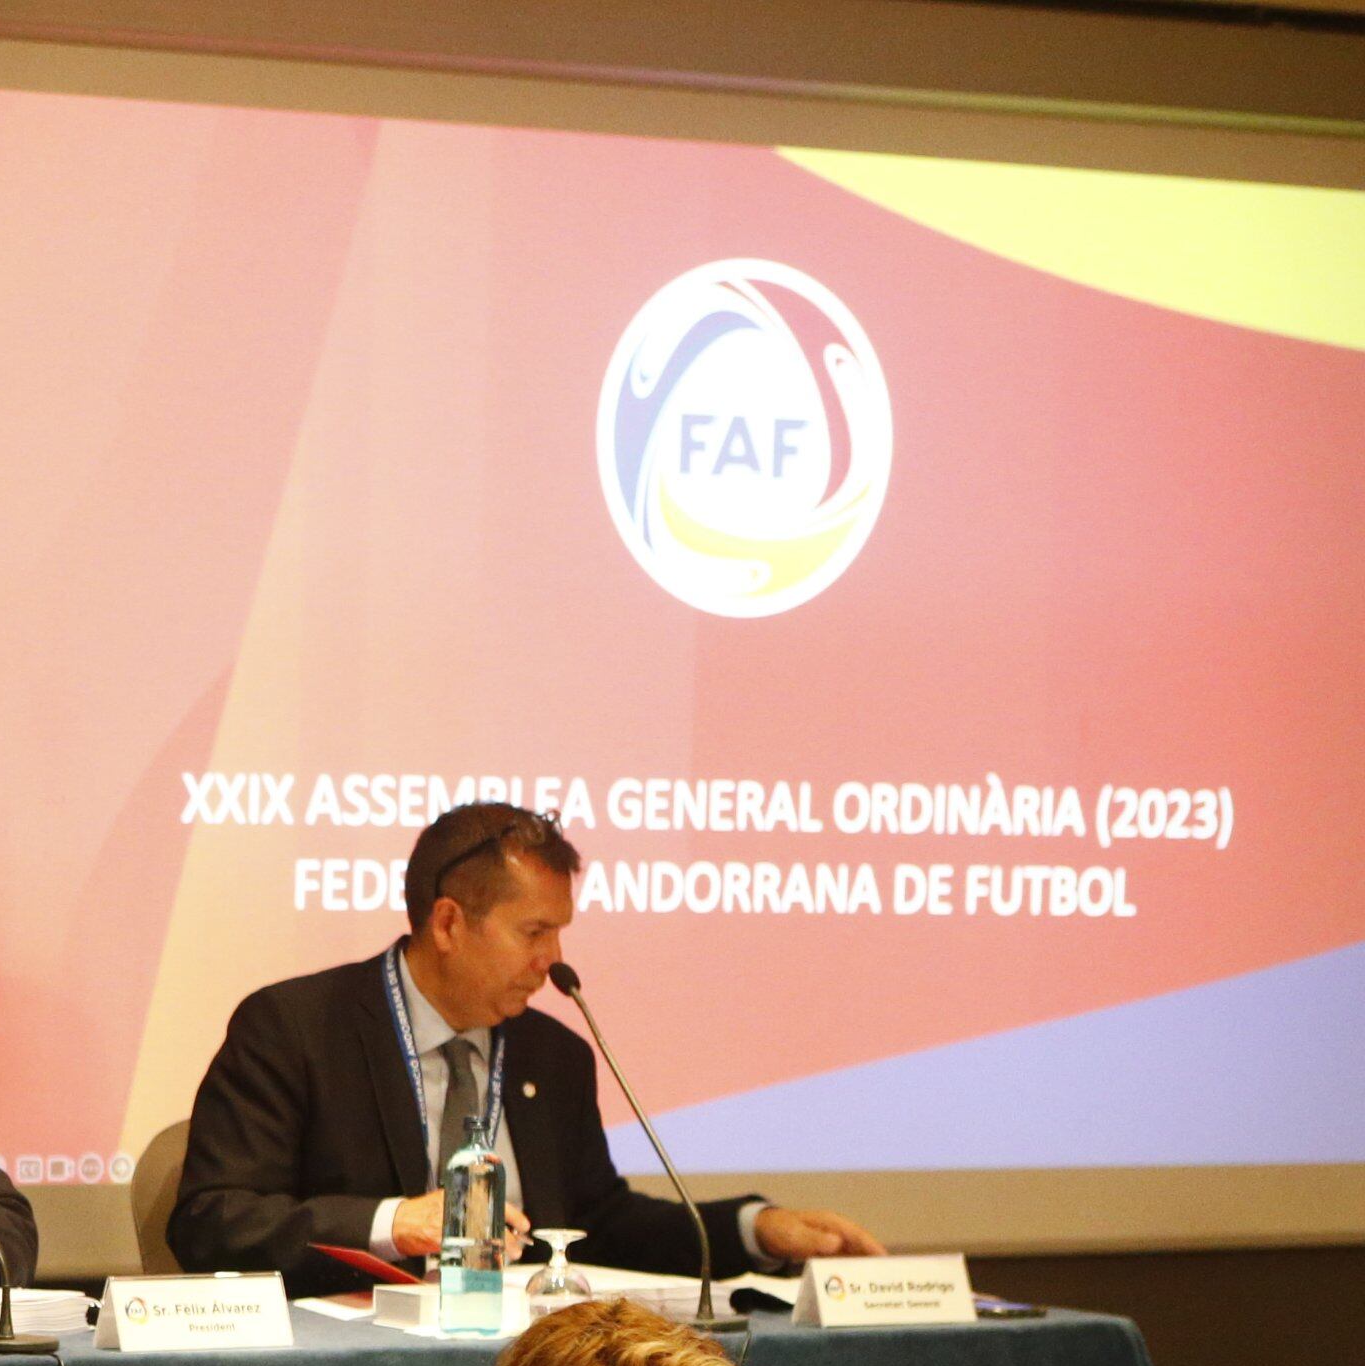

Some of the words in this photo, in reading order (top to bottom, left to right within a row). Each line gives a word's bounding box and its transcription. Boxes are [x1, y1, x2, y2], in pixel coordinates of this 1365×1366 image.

[679, 413, 810, 479] FAF
[181, 771, 295, 825] XXIX
[607, 778, 823, 833] GENERAL
[833, 771, 1086, 838] ORDINÀRIA
[1096, 783, 1234, 850] (2023)
[294, 859, 408, 911] FEDE
[576, 860, 882, 915] ANDORRANA
[893, 864, 954, 915] DE
[965, 864, 1138, 917] FUTBOL
[153, 1305, 171, 1317] Sr.
[189, 1322, 236, 1332] President
